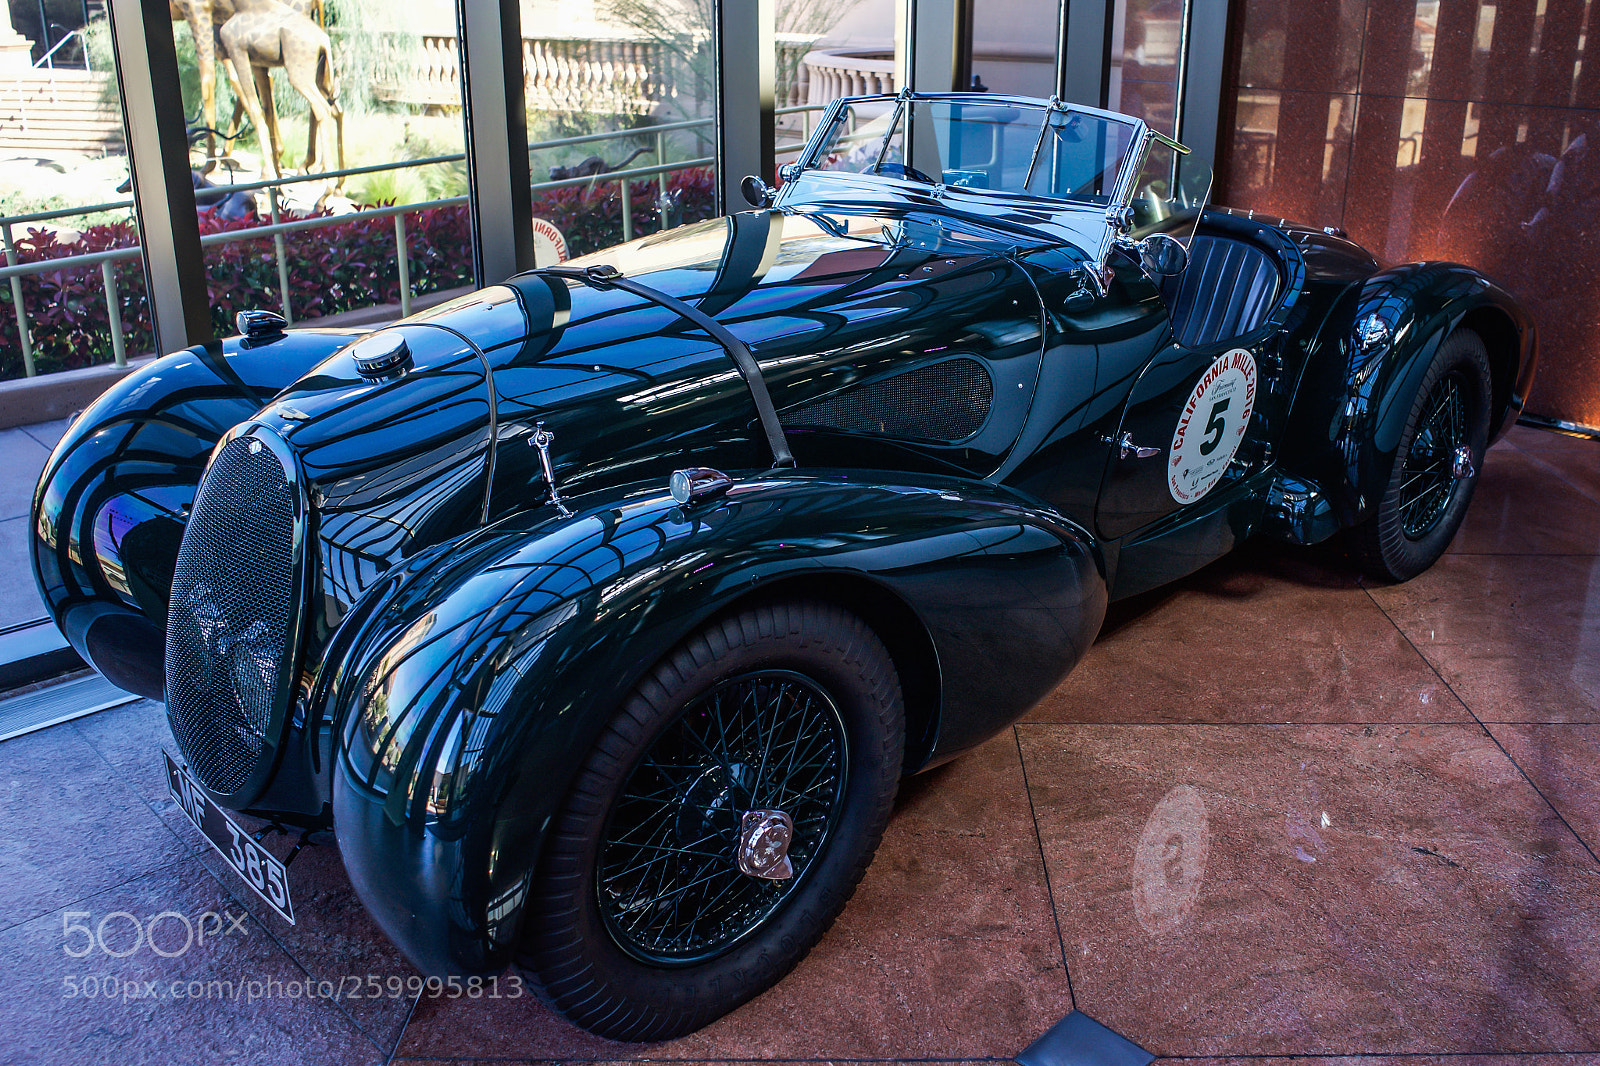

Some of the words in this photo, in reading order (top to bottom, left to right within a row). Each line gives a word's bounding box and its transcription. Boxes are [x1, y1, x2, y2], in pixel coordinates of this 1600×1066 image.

[1231, 352, 1254, 382] MILLE
[1173, 355, 1229, 450] CALIFORNIA
[1199, 397, 1231, 456] 5
[1242, 378, 1255, 420] 2016
[163, 753, 206, 829] LMF
[225, 820, 286, 909] 385
